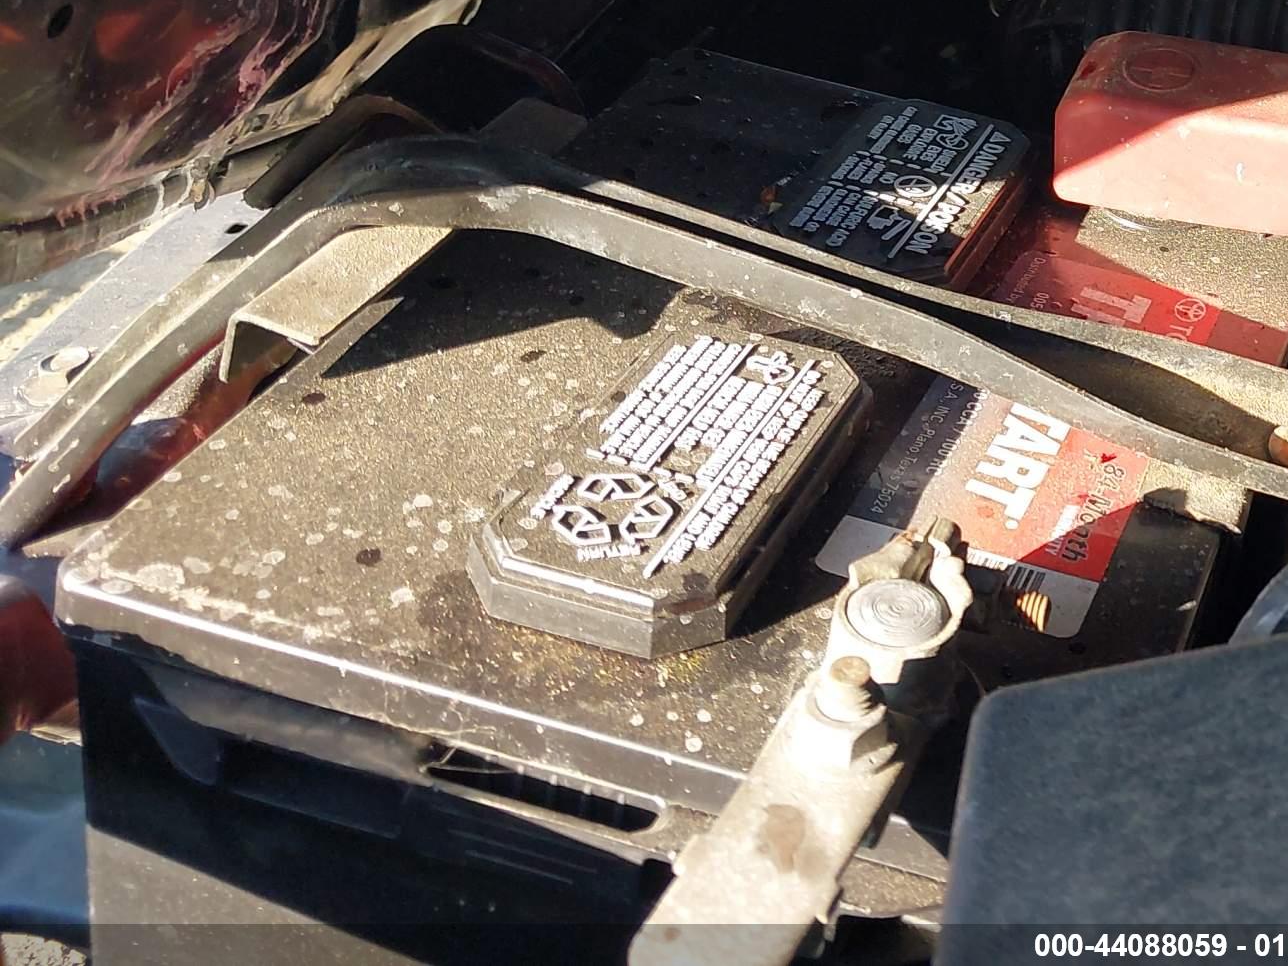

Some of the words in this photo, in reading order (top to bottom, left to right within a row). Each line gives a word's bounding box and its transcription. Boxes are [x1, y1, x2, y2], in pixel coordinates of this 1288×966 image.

[897, 124, 922, 143] GASES
[903, 128, 938, 160] EXPLOSIVE
[920, 145, 942, 161] EYES
[879, 172, 898, 184] NO
[841, 196, 880, 229] SULFURIC
[956, 401, 983, 426] CCA
[906, 427, 935, 454] Plano,
[871, 481, 899, 513] 75024
